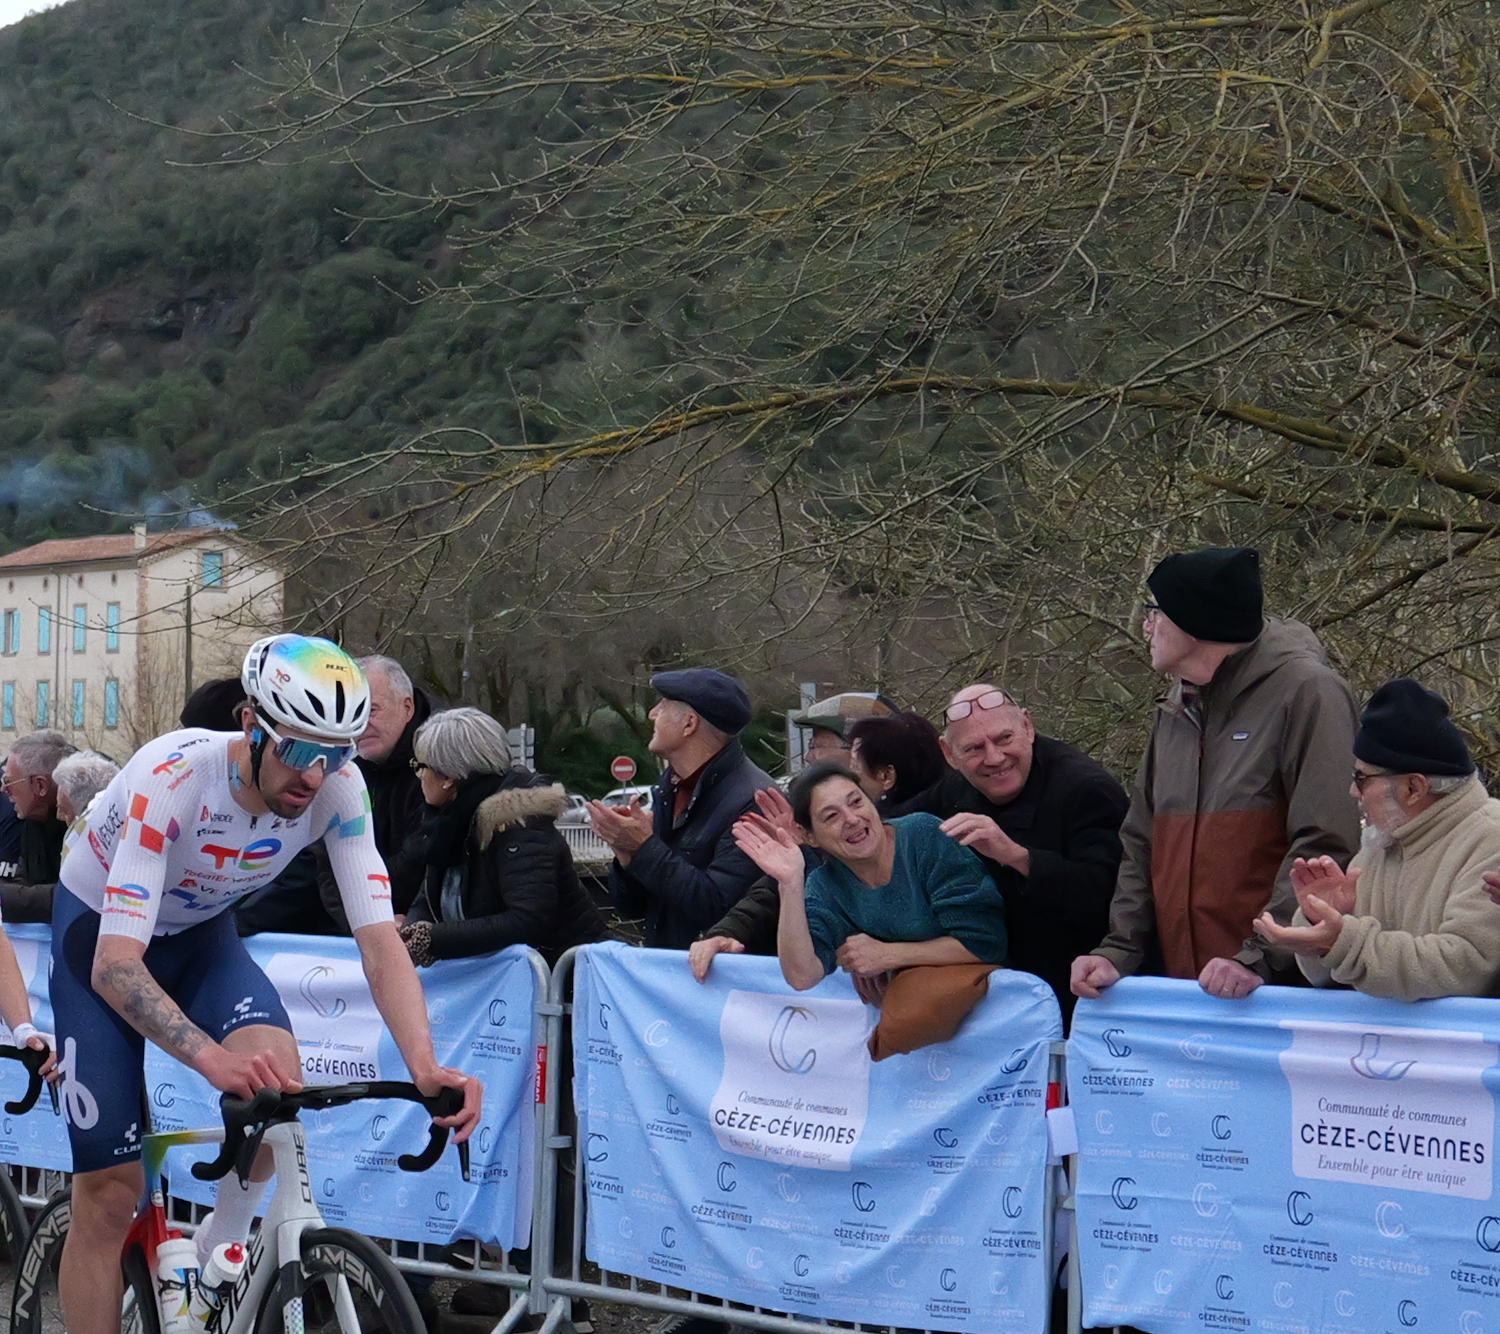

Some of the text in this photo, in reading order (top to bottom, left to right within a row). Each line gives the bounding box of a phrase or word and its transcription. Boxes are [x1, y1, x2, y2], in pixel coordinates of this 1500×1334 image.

[222, 1010, 271, 1032] CUBE
[300, 1052, 376, 1079] -CÉVENNES
[714, 1106, 857, 1145] CÈZE-CÉVENNES
[1317, 1097, 1468, 1128] Communauté de communes
[113, 1144, 142, 1156] CUB
[1300, 1118, 1485, 1165] CÈZE-CÉVENNES
[1317, 1154, 1369, 1173] Ensemble
[1370, 1164, 1399, 1180] pour
[1426, 1170, 1467, 1190] unique
